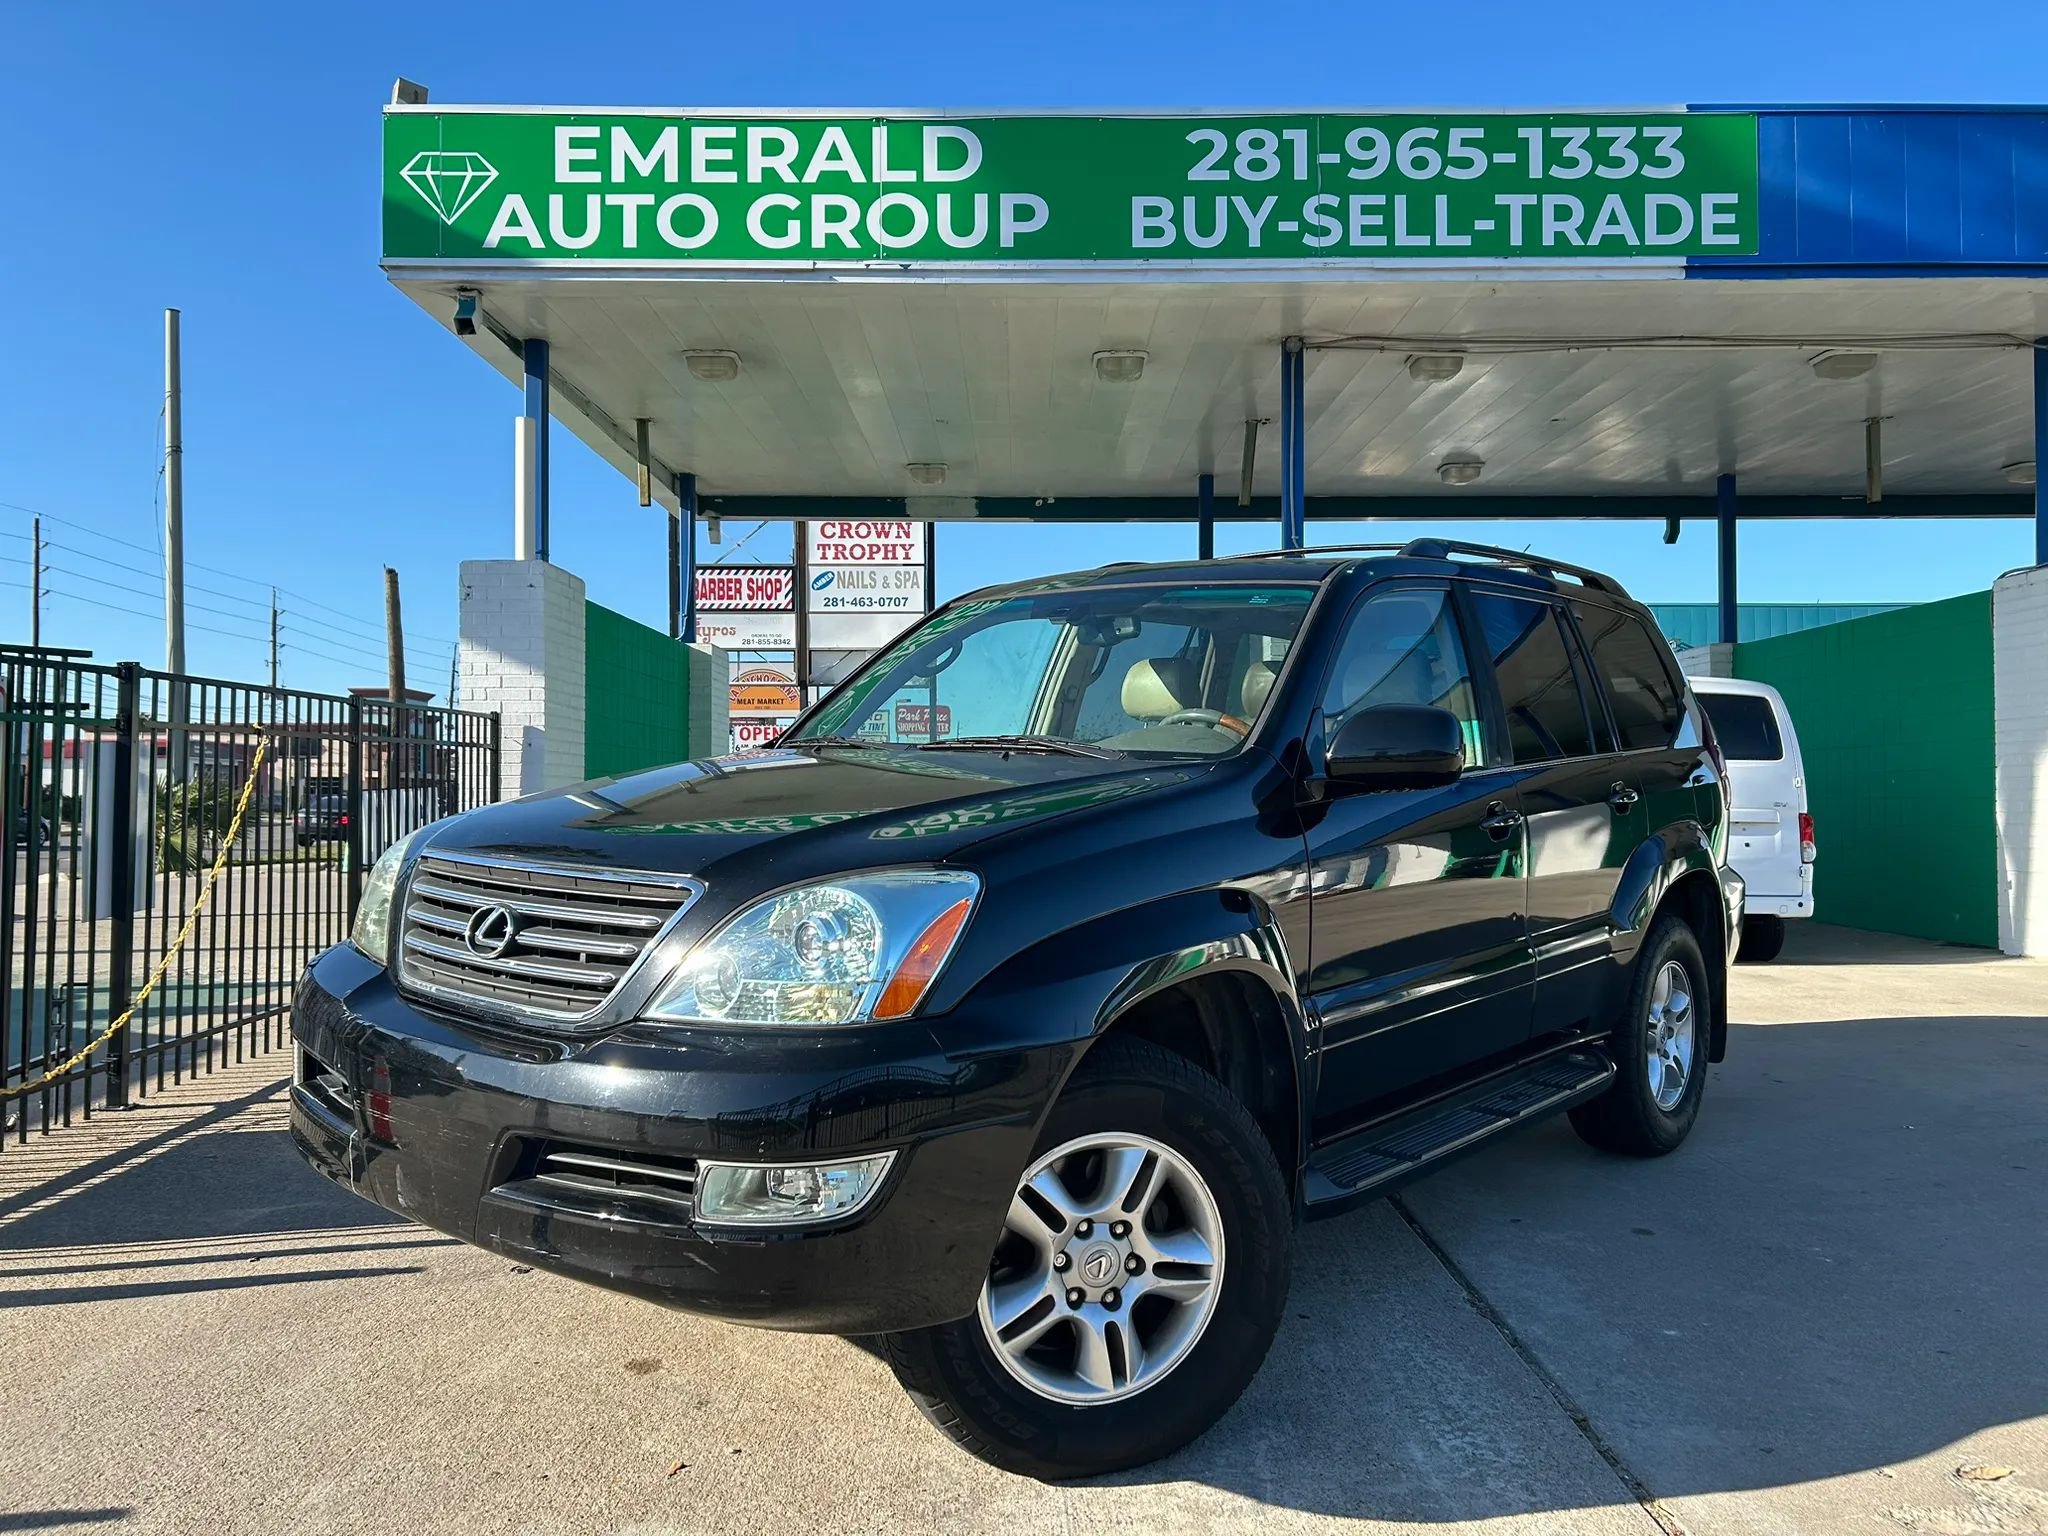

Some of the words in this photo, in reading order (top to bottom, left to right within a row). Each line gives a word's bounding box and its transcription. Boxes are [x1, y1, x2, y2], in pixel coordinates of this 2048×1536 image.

[554, 126, 982, 184] EMERALD
[1185, 126, 1685, 181] 281-965-1333
[482, 193, 719, 250] AUTO
[745, 192, 1050, 250] GROUP
[1130, 193, 1740, 248] BUY-SELL-TRADE
[820, 522, 912, 539] CROWN
[817, 544, 914, 560] TROPHY
[813, 572, 834, 590] AMBER
[837, 571, 877, 589] NAILS
[882, 576, 891, 589] &
[895, 570, 920, 589] SPA
[747, 577, 782, 601] SHOP
[823, 597, 909, 607] 281-463-0707
[898, 708, 920, 721] Park
[924, 708, 948, 721] Pce
[739, 727, 784, 741] OPEN
[868, 722, 885, 731] TINT
[928, 722, 949, 732] TER
